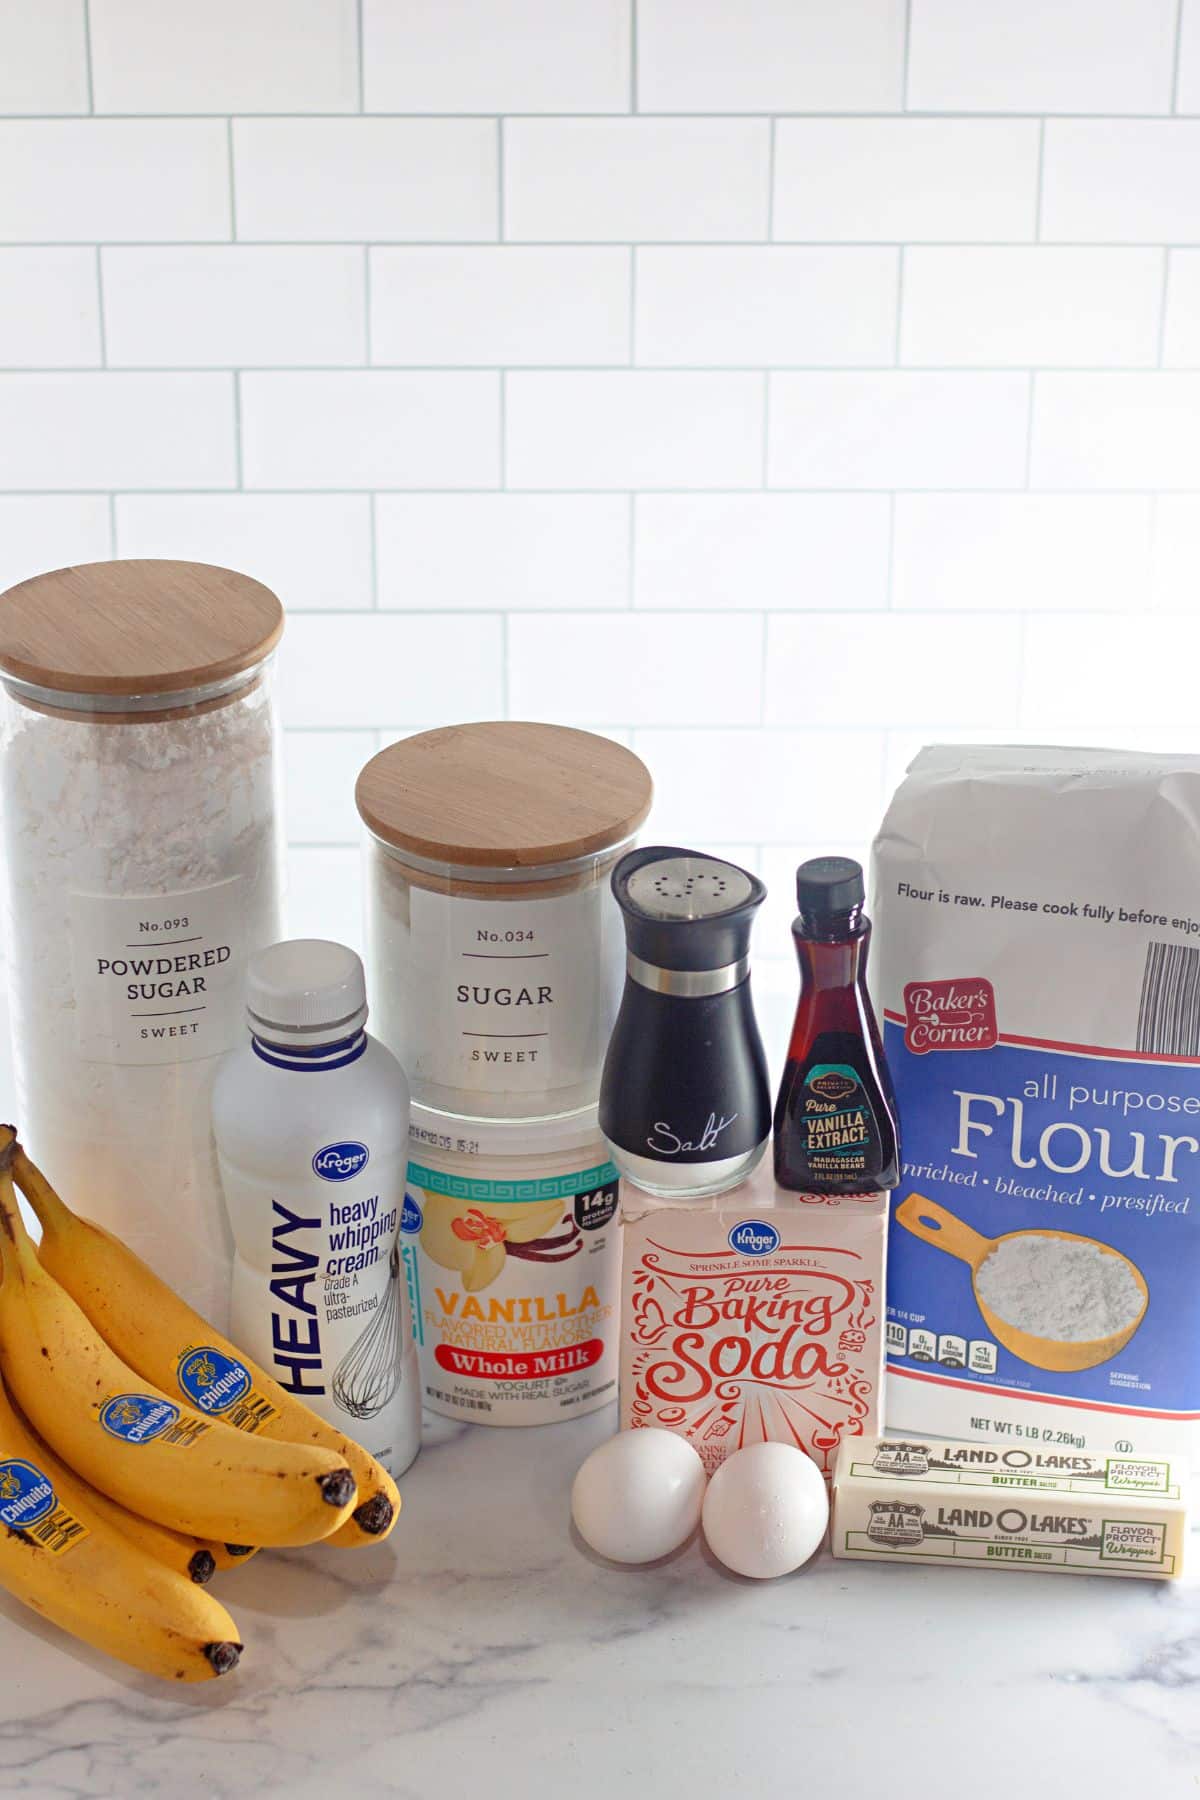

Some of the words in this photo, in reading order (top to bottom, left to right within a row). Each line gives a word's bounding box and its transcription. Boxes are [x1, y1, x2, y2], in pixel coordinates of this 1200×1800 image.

[897, 882, 934, 902] Flour
[938, 890, 950, 903] is
[954, 894, 985, 907] raw.
[991, 895, 1038, 913] Please
[1042, 901, 1078, 916] cook
[1083, 904, 1115, 923] fully
[1118, 908, 1167, 926] before
[139, 917, 189, 932] No.093
[477, 930, 535, 942] No.034
[97, 946, 231, 976] POWDERED
[127, 977, 207, 1000] SUGAR
[457, 985, 554, 1006] SUGAR
[909, 986, 989, 1015] Baker's
[140, 1023, 200, 1039] SWEET
[910, 1024, 989, 1048] Corner
[471, 1050, 538, 1063] SWEET
[805, 1099, 837, 1113] Pure
[1023, 1073, 1057, 1101] all
[1069, 1084, 1200, 1117] purpose
[647, 1112, 738, 1154] Salt
[807, 1111, 865, 1134] VANILLA
[807, 1127, 865, 1149] EXTRACT
[951, 1089, 1200, 1184] Flour
[317, 1151, 366, 1174] Kroger
[902, 1162, 977, 1188] nriched
[995, 1176, 1083, 1206] bleached
[1100, 1194, 1191, 1216] presifted
[330, 1196, 378, 1226] heavy
[582, 1190, 614, 1211] 14g
[582, 1206, 613, 1222] protein
[329, 1208, 396, 1251] whipping
[737, 1228, 774, 1250] Kroger
[327, 1246, 379, 1276] cream
[689, 1260, 738, 1272] SPRINKLE
[741, 1259, 771, 1269] SOME
[324, 1275, 350, 1291] Grade
[352, 1273, 359, 1286] A
[270, 1200, 325, 1395] HEAVY
[324, 1292, 351, 1306] ultra-
[326, 1292, 378, 1324] pasteurized
[434, 1285, 600, 1323] VANILLA
[424, 1309, 507, 1338] FLAVORED
[511, 1323, 558, 1340] WITH
[562, 1304, 613, 1331] OTHER
[673, 1287, 834, 1336] Baking
[909, 1313, 925, 1323] CUP
[441, 1331, 518, 1350] NATURAL
[524, 1329, 593, 1350] FLAVORS
[450, 1352, 529, 1375] Whole
[533, 1348, 590, 1373] Milk
[645, 1324, 849, 1403] Soda
[198, 1367, 246, 1410] Chiquita
[454, 1385, 486, 1399] MADE
[488, 1391, 519, 1401] WITH
[521, 1389, 551, 1400] REAL
[552, 1380, 591, 1397] SUGAR
[494, 1380, 550, 1392] YOGURT
[127, 1405, 172, 1441] Chiquita
[970, 1416, 990, 1431] NET
[994, 1419, 1014, 1434] WT
[1015, 1421, 1023, 1436] 5
[1025, 1423, 1039, 1439] LB
[1042, 1425, 1086, 1449] (2.26kg)
[895, 1452, 909, 1462] AA
[944, 1448, 998, 1464] LAND
[1002, 1450, 1032, 1468] O
[1036, 1454, 1093, 1470] LAKES
[1115, 1463, 1158, 1472] FLAVOR
[992, 1476, 1037, 1487] BUTTER
[1110, 1469, 1161, 1478] PROTECT
[0, 1482, 52, 1522] Chiquita
[888, 1513, 904, 1528] AA
[938, 1508, 993, 1528] LAND
[996, 1509, 1028, 1534] O
[1030, 1514, 1088, 1534] LAKES
[1110, 1526, 1154, 1537] FLAVOR
[1106, 1532, 1157, 1544] PROTECT
[987, 1546, 1032, 1559] BUTTER
